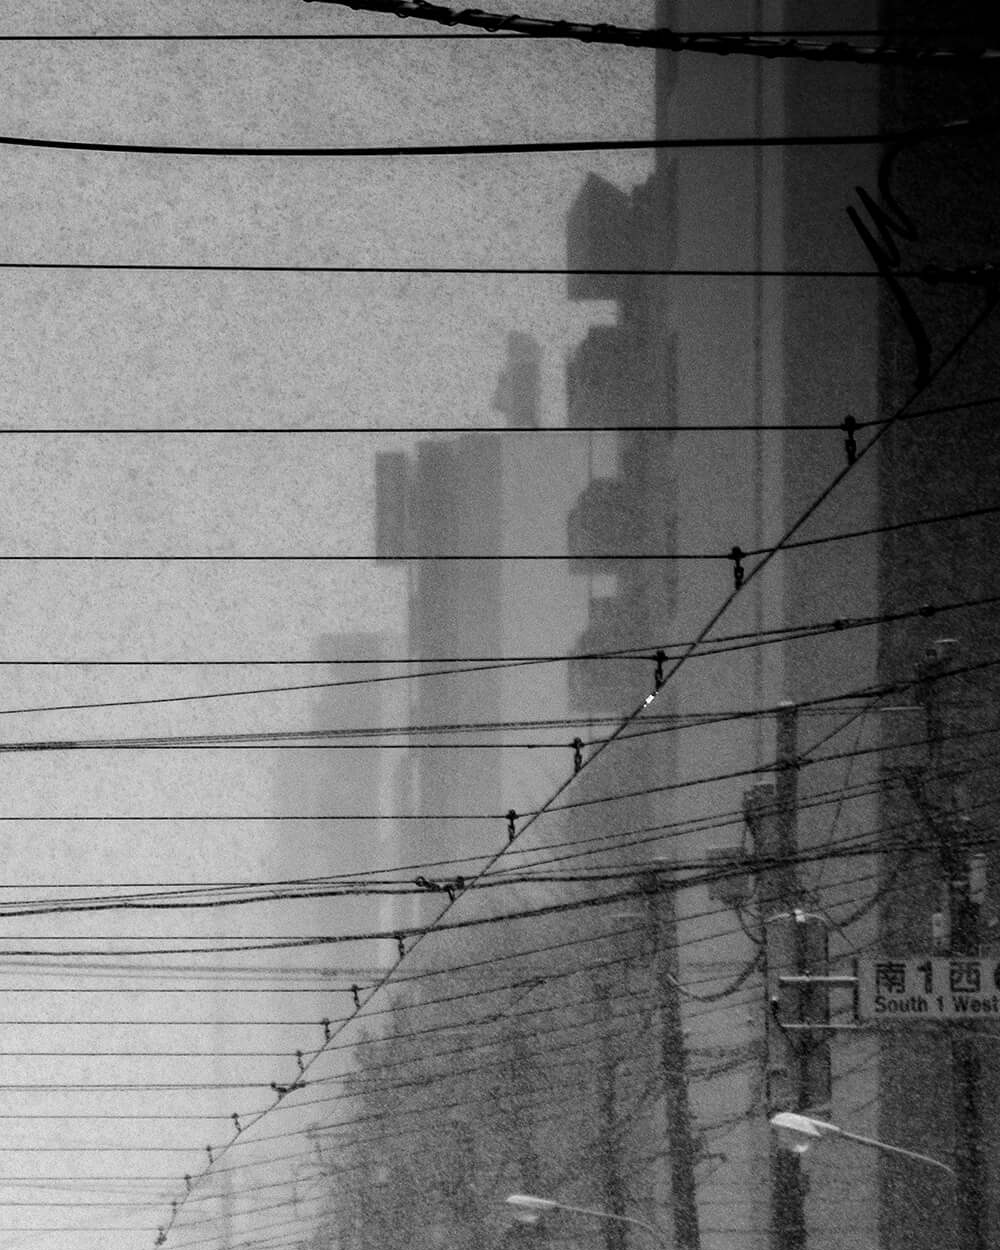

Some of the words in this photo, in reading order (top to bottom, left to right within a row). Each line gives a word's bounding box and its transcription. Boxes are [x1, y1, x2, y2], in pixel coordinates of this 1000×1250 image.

[875, 995, 928, 1013] South
[936, 996, 944, 1012] 1
[952, 995, 999, 1013] West
